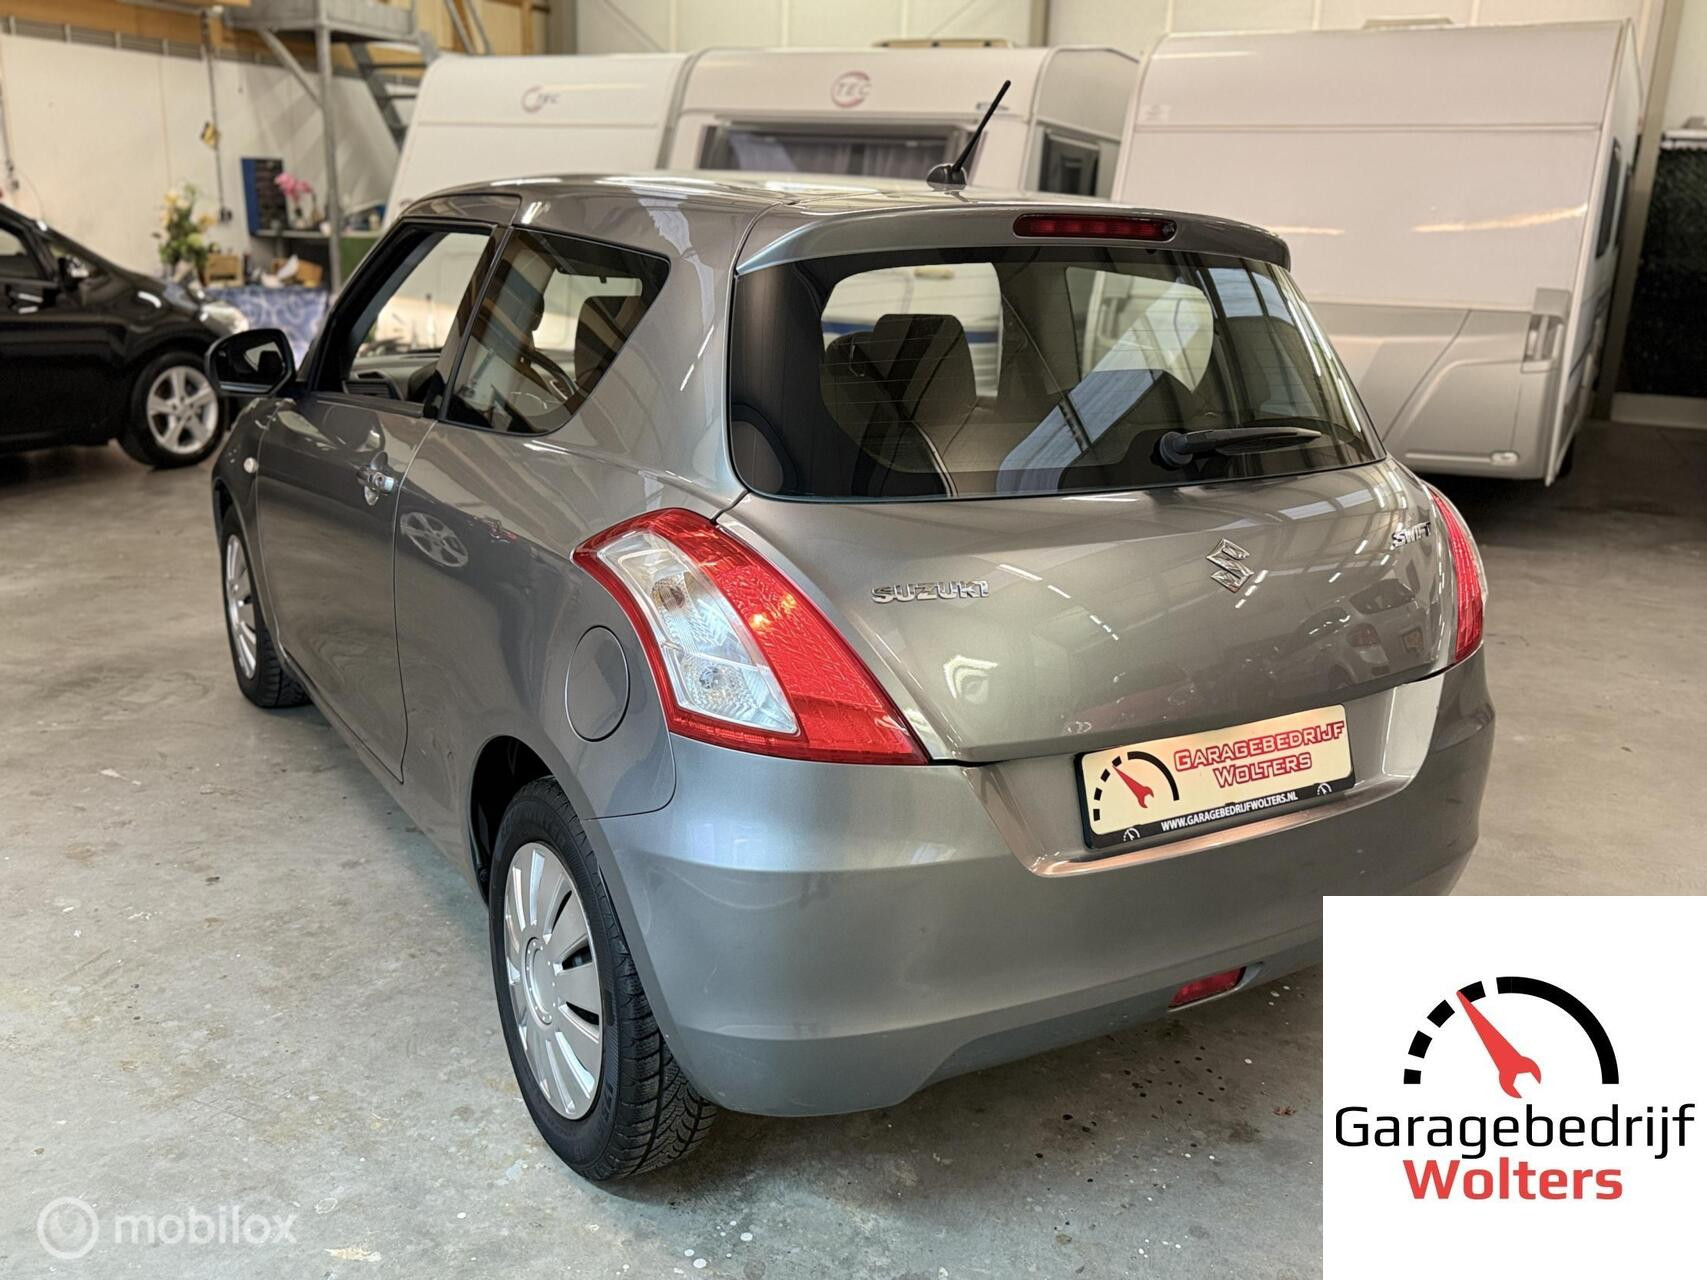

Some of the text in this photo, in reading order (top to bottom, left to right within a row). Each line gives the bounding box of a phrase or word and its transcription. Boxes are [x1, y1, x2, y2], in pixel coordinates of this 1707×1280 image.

[871, 580, 990, 604] SUZUKI
[1174, 720, 1344, 772] GARAGEBEDRIJF
[1214, 752, 1313, 789] WOLTERS
[1161, 791, 1298, 832] WWW.GARAGEBEDRIJFWOLTERS.NL
